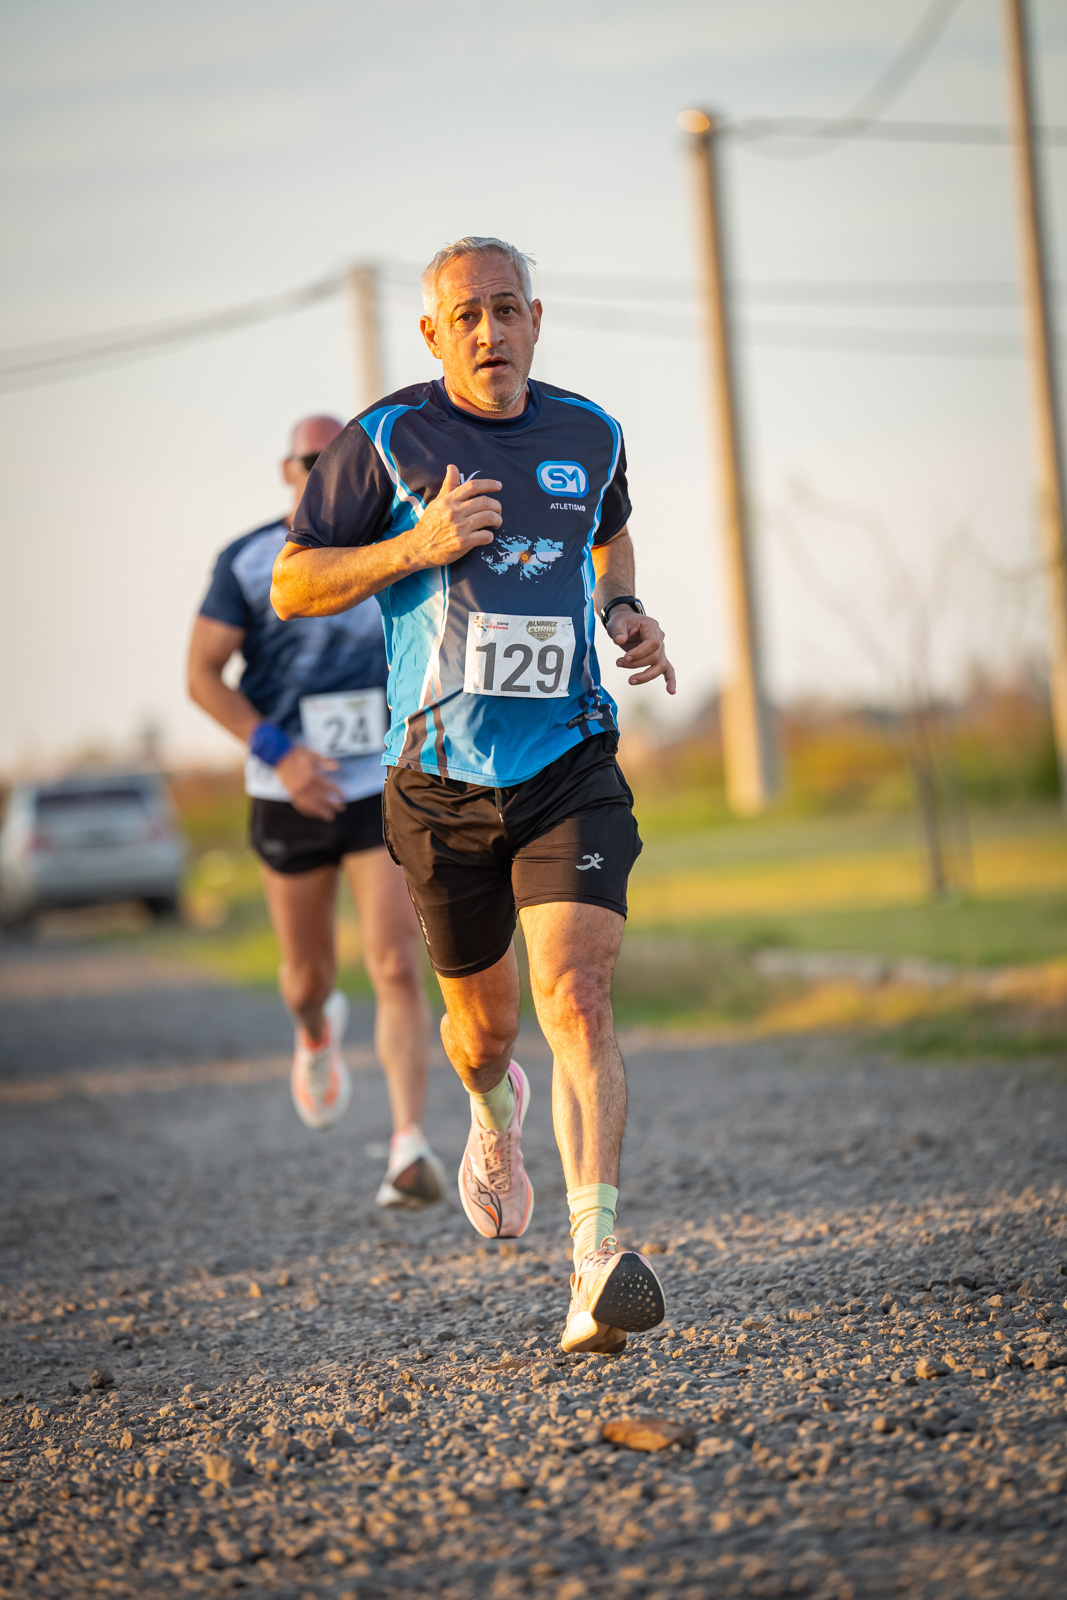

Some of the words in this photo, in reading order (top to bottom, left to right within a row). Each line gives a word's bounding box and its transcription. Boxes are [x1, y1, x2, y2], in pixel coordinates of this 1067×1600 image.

[550, 502, 586, 512] ATLETISMO
[475, 642, 565, 694] 129
[323, 717, 370, 755] 24
